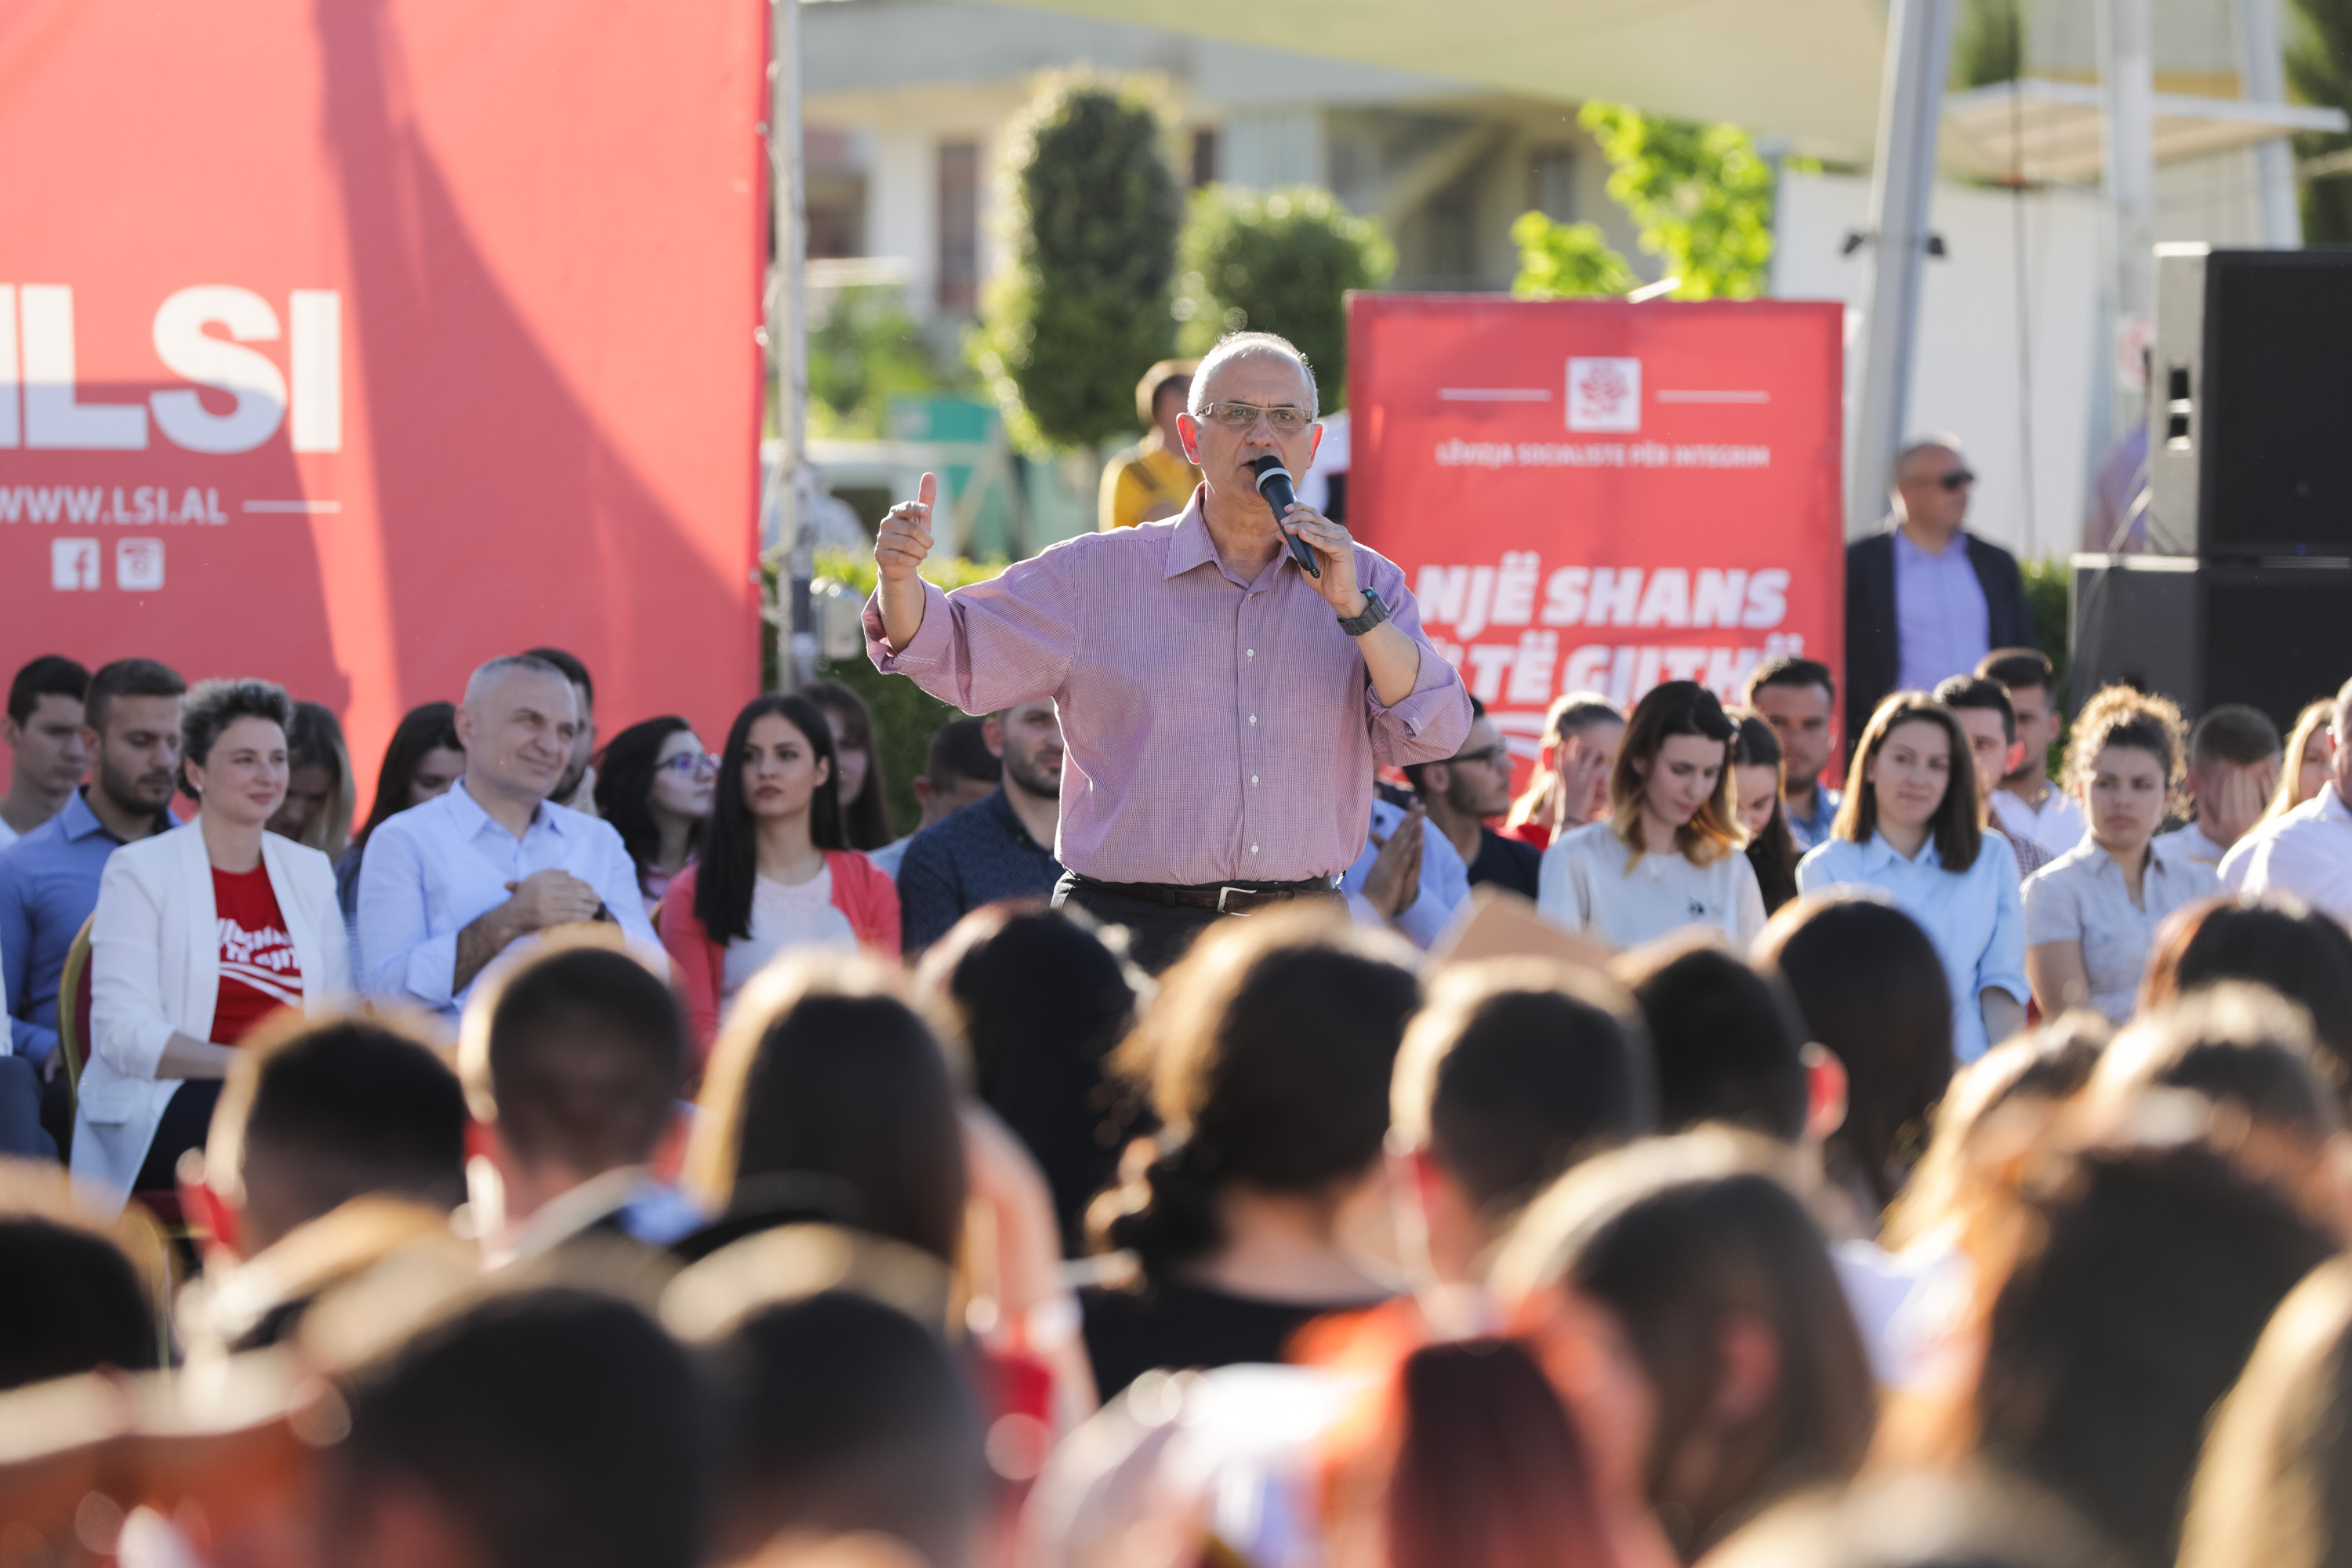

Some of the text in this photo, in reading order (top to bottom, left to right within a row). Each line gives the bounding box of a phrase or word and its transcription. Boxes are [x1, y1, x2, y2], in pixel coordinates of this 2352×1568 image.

[1516, 441, 1627, 468] SOCIALISTE
[1630, 439, 1670, 468] PËR
[1673, 444, 1771, 469] INTEGRIM
[1414, 550, 1791, 641] NJË SHANS
[1468, 629, 1559, 705] TË
